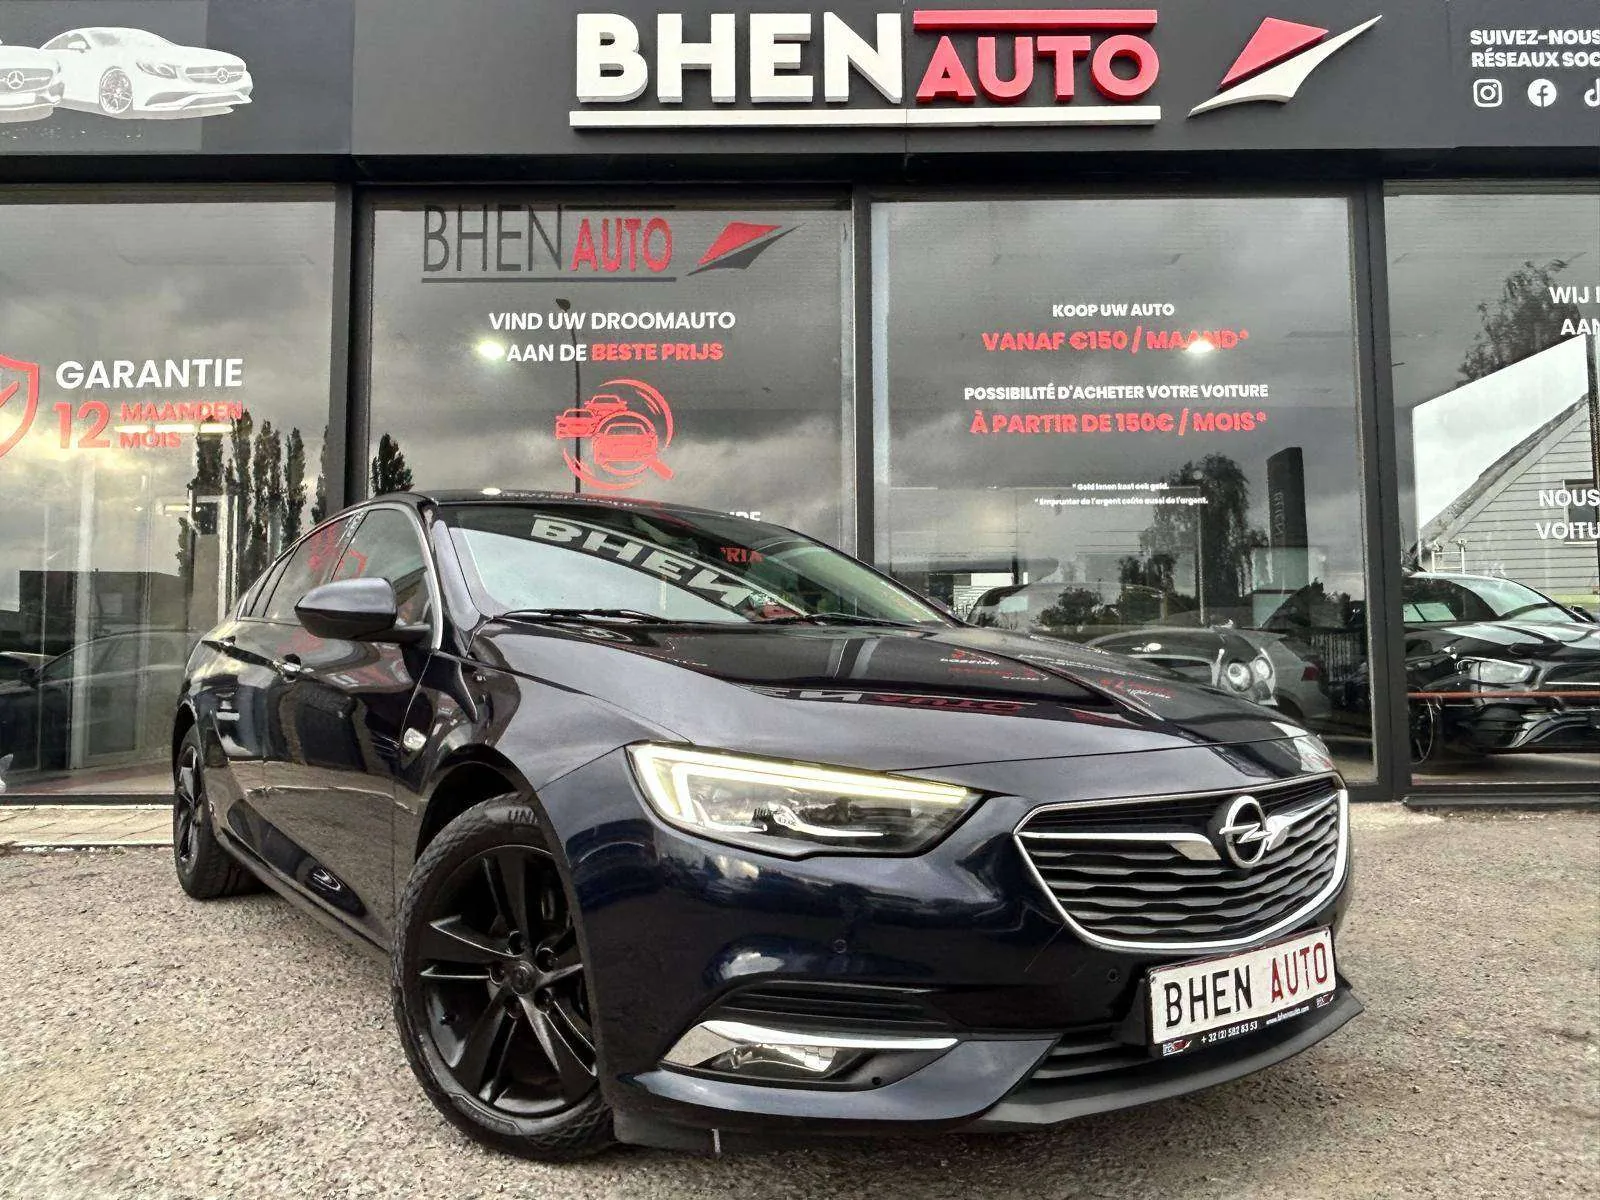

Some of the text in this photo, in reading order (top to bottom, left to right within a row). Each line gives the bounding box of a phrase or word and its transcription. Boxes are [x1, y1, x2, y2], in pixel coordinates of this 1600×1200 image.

[575, 12, 1160, 105] BHEN AUTO
[1471, 47, 1559, 67] RÉSEAUX
[422, 204, 674, 273] BHEN AUTO
[1548, 286, 1590, 304] WIJ
[1052, 303, 1175, 318] KOOP UW AUTO
[488, 311, 736, 330] VIND UW DROOMAUTO
[981, 331, 1065, 351] VANAF
[1069, 331, 1128, 350] €150
[1131, 325, 1142, 354] /
[506, 343, 724, 361] AAN DE BESTE PRIJS
[55, 358, 243, 390] GARANTIE
[964, 382, 1269, 400] POSSIBILITÉ D'ACHETER VOTRE VOITURE
[53, 400, 243, 449] 12 MAANDEN
[969, 409, 987, 433] À
[992, 413, 1077, 433] PARTIR
[1081, 413, 1112, 432] DE
[1115, 413, 1174, 432] 150€
[1178, 408, 1189, 436] /
[119, 430, 181, 448] MOIS
[1539, 489, 1600, 507] NOUS
[1535, 521, 1600, 540] VOITU
[1164, 942, 1328, 1028] BHEN AUTO
